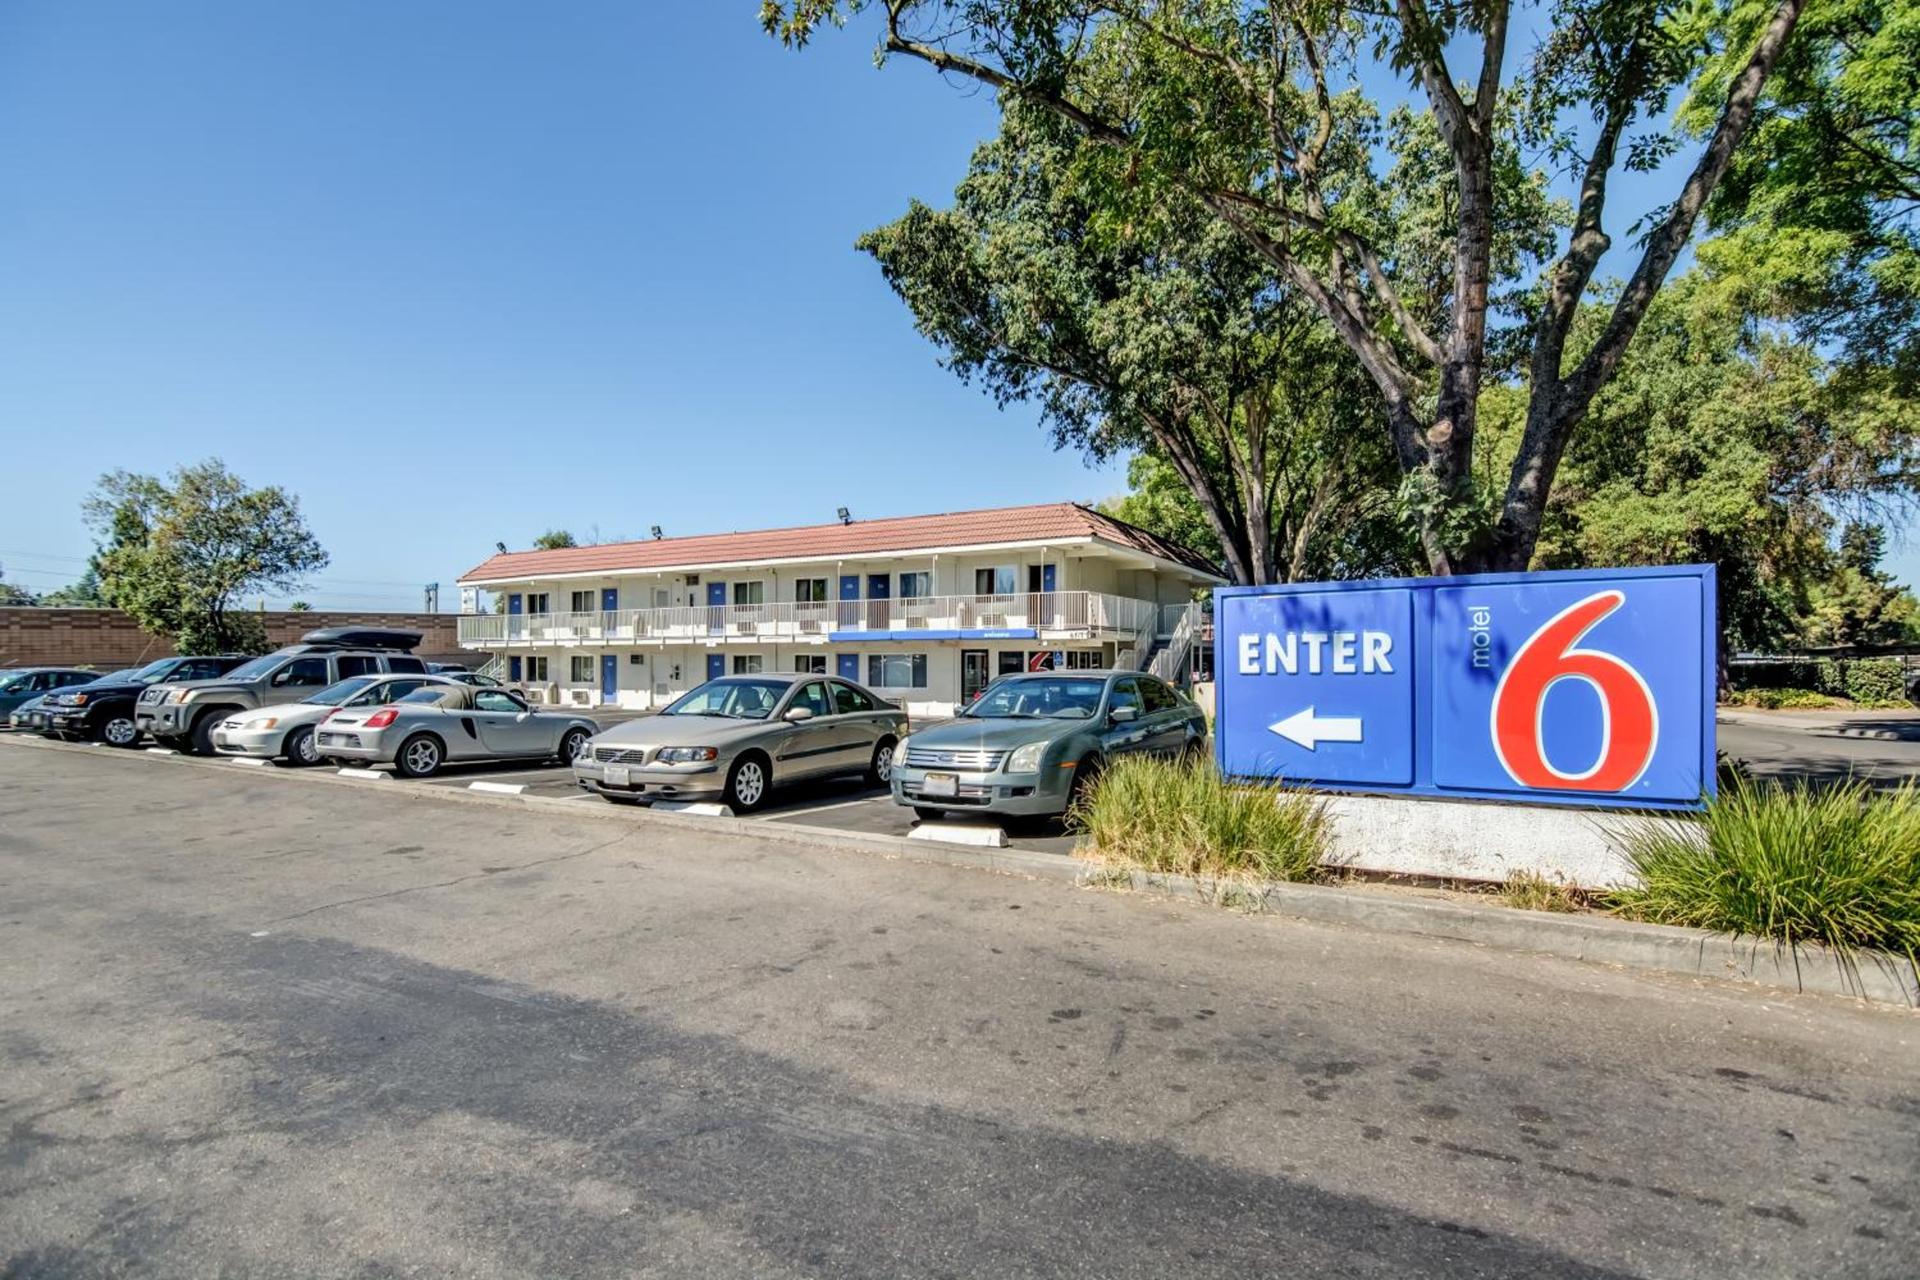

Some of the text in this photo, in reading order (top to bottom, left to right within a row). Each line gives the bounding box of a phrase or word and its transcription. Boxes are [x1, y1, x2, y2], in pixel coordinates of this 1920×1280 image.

[1238, 629, 1395, 675] ENTER
[1467, 589, 1659, 793] motel 6
